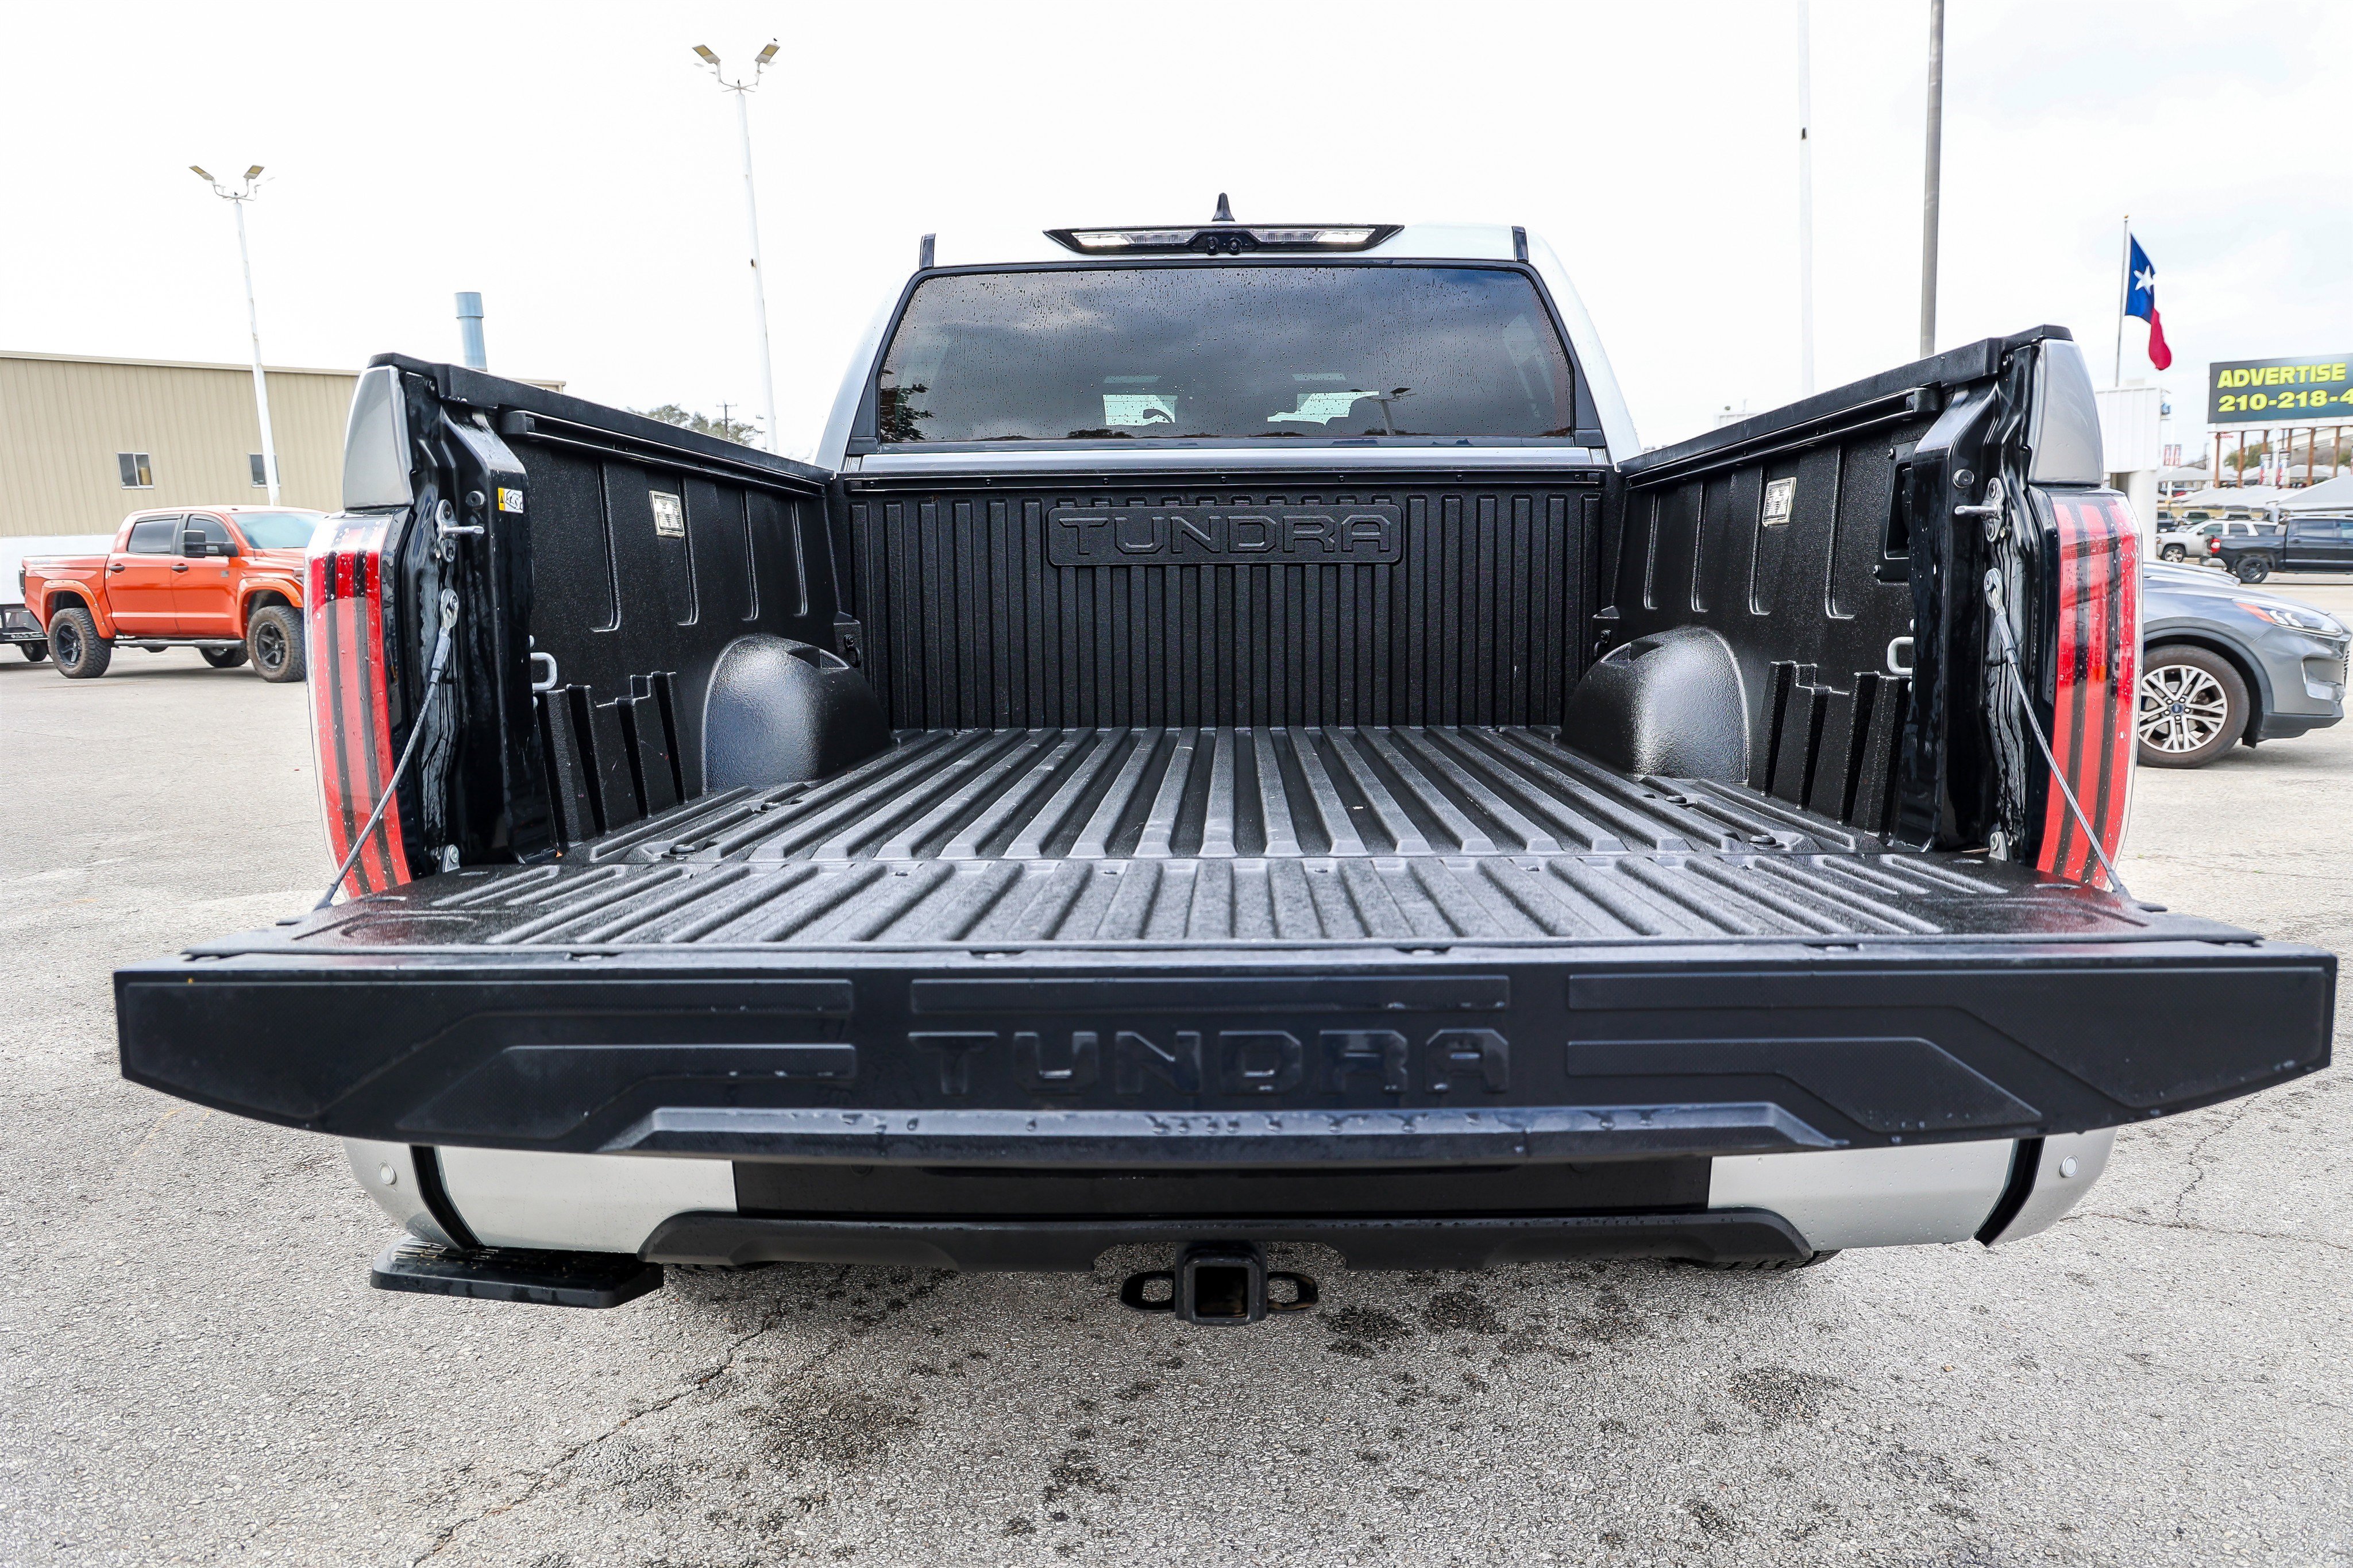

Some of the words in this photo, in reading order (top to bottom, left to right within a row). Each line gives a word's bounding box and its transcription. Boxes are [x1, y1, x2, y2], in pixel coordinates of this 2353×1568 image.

[2217, 362, 2346, 388] ADVERTISE
[2217, 388, 2353, 412] 210-218-4
[1059, 515, 1391, 554] TUNDRA
[909, 1029, 1510, 1095] TUNDRA
